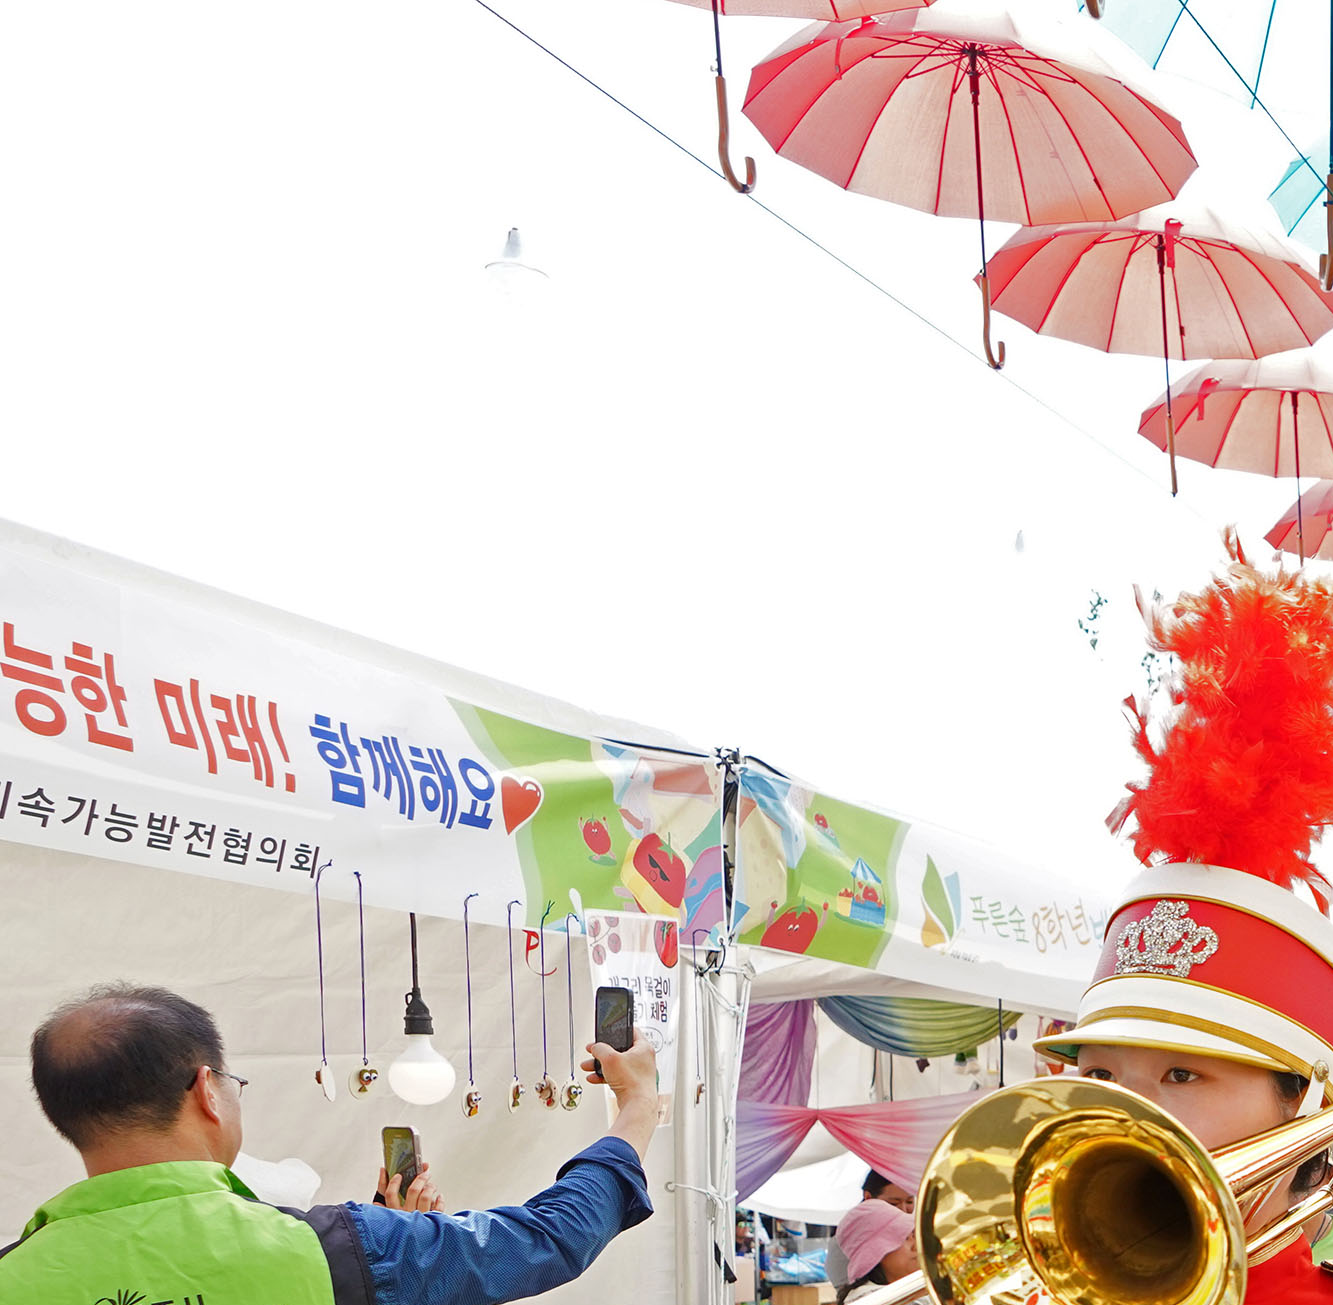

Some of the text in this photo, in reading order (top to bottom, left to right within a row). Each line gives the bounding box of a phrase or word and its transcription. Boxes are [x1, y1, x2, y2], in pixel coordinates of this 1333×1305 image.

[153, 677, 296, 793] 미래!
[309, 713, 496, 830] 함께해요
[970, 896, 1029, 943] 푸른숲
[644, 976, 671, 999] 목걸이
[651, 1001, 668, 1023] 체험
